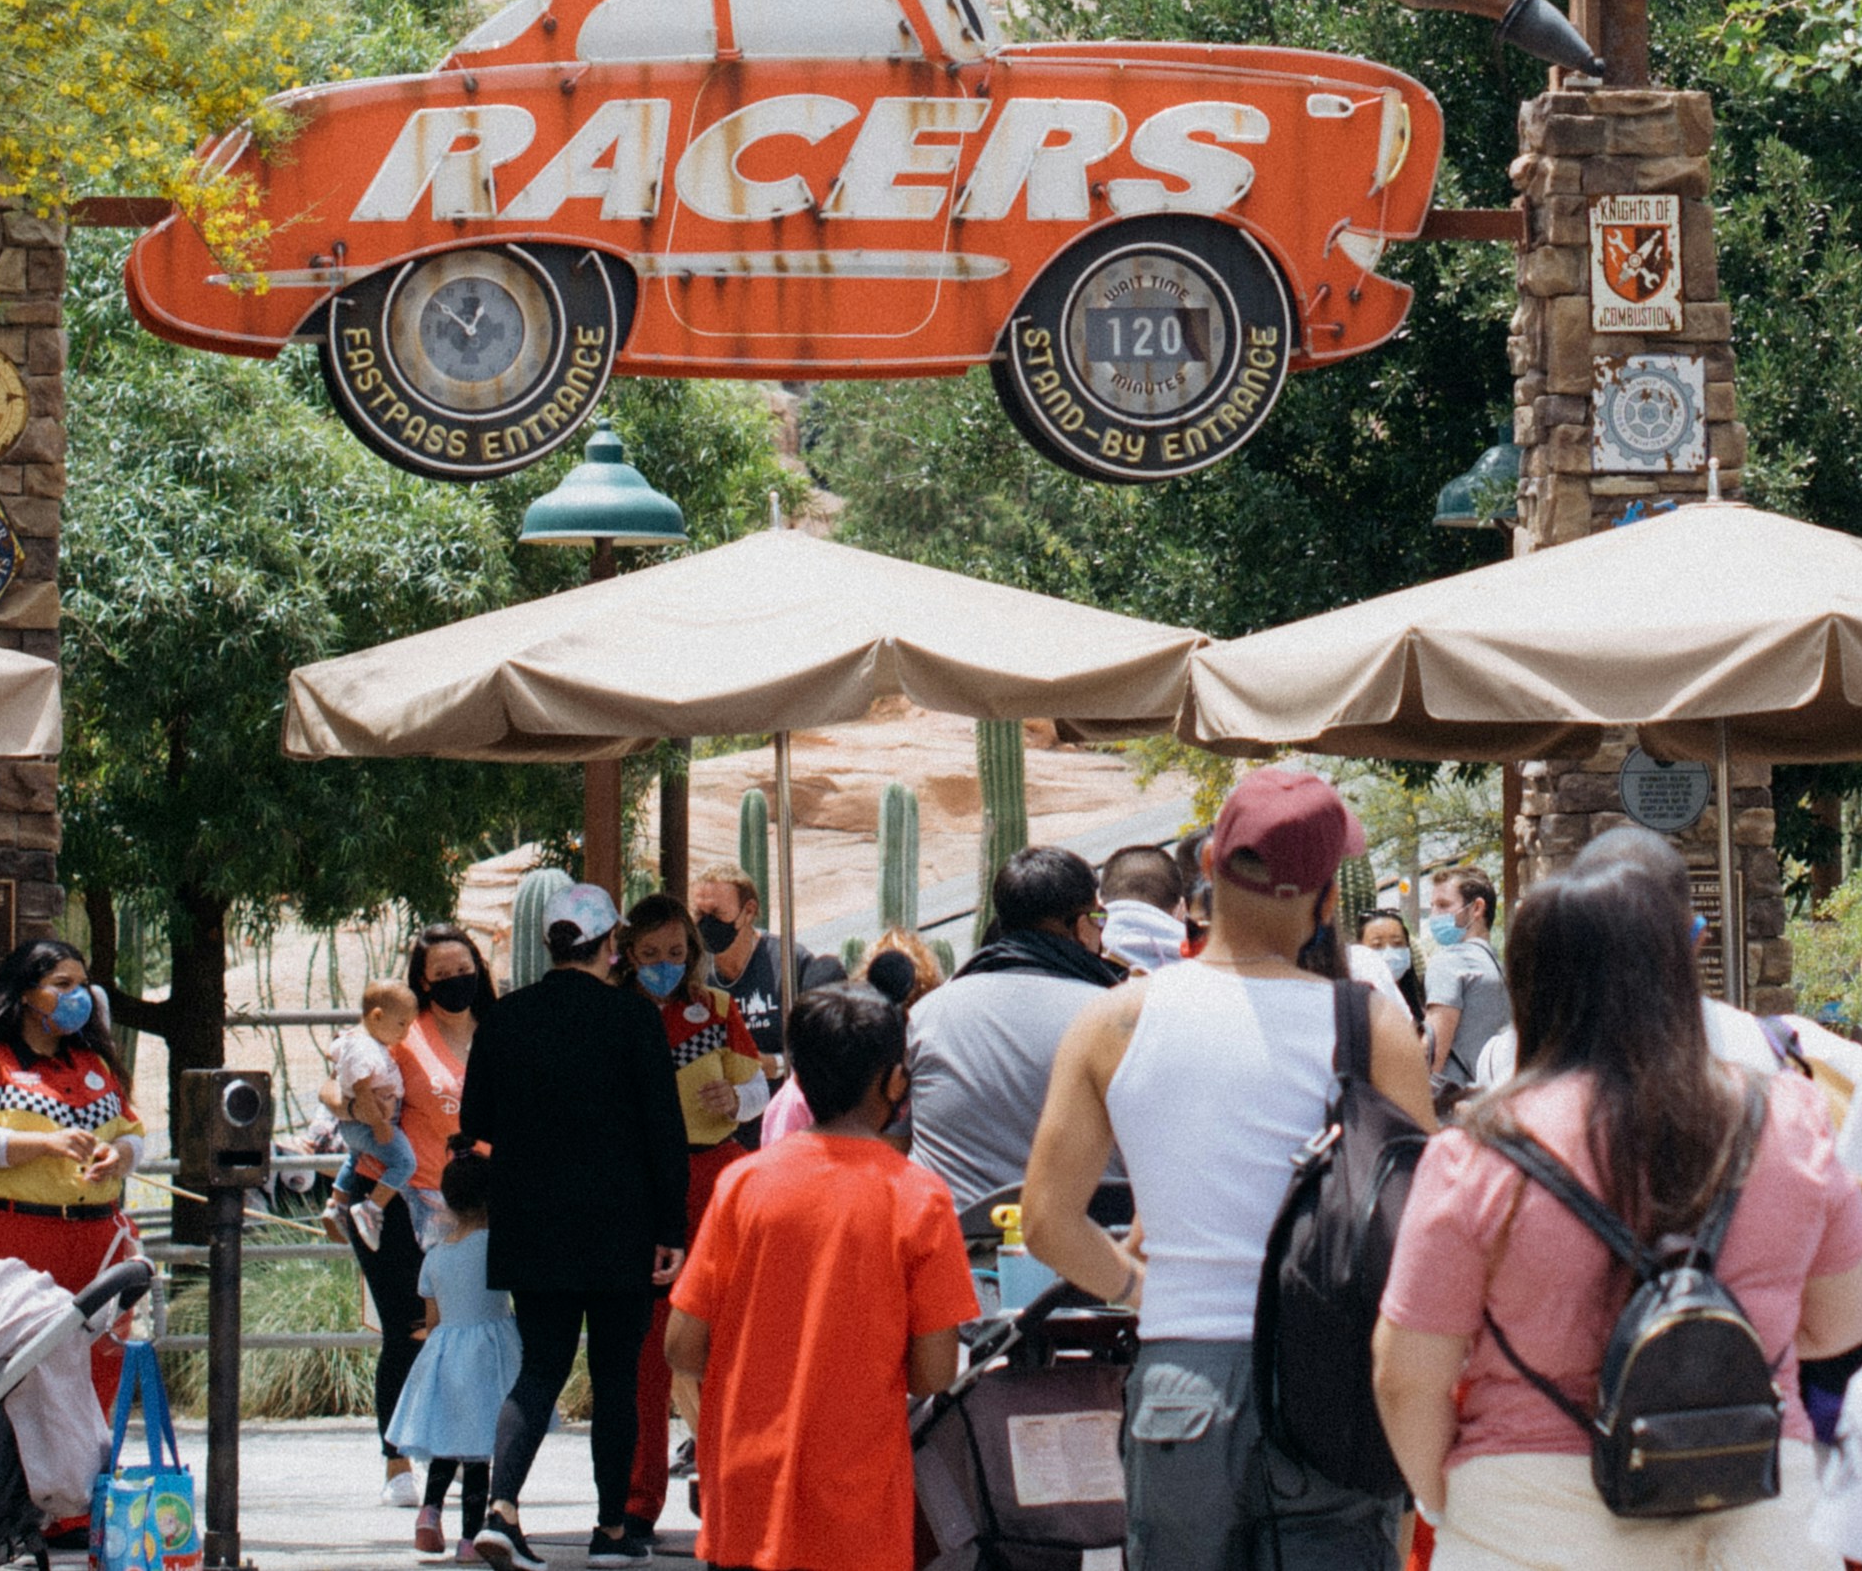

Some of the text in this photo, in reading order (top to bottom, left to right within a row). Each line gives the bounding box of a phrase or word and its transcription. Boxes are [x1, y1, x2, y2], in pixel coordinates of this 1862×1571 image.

[348, 93, 1271, 223] RACERS
[1599, 199, 1672, 222] KNIGHTS OF
[1103, 275, 1191, 302] WAIT TIME
[1602, 306, 1672, 328] COMBUSTION
[1107, 315, 1183, 357] 120
[343, 324, 606, 462] FASTPASS ENTRANCE
[1023, 324, 1278, 464] STAND-BY ENTRANCE
[1110, 371, 1187, 396] MINUTES
